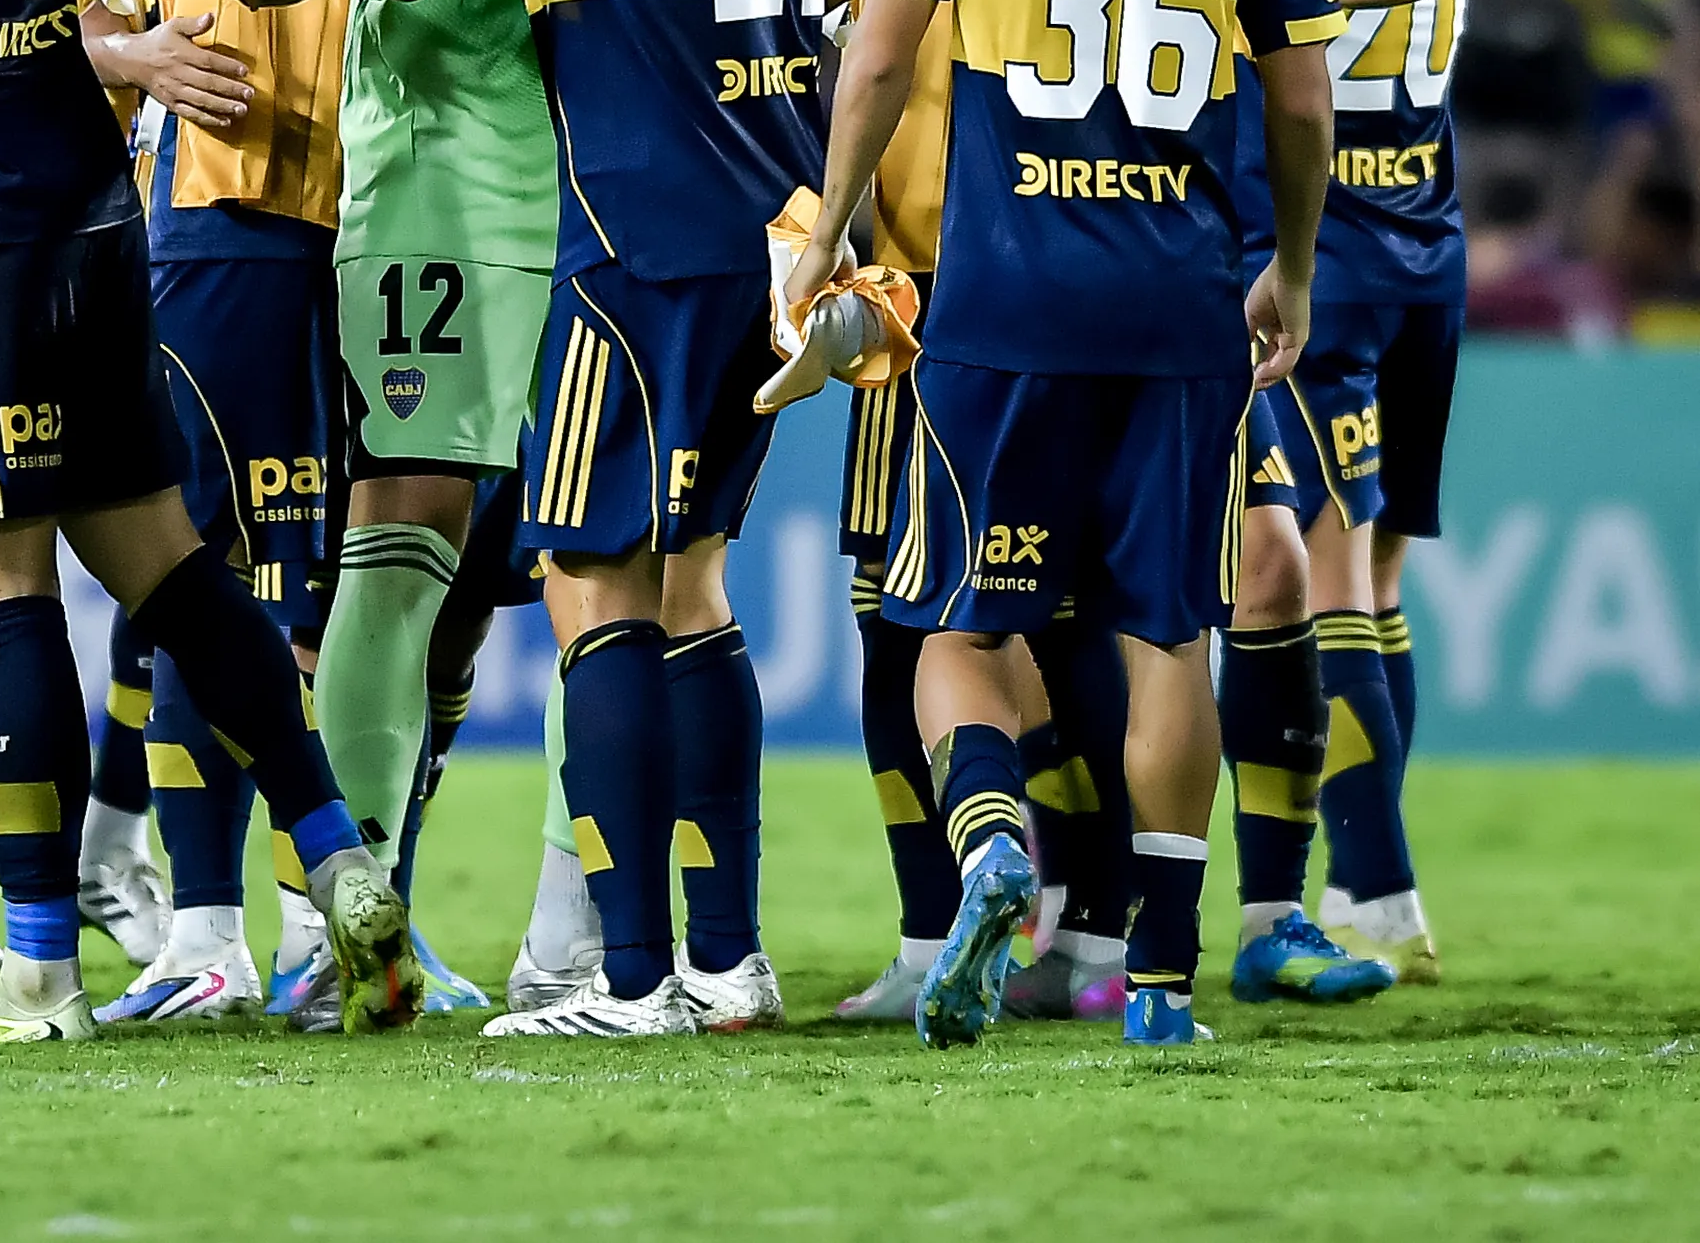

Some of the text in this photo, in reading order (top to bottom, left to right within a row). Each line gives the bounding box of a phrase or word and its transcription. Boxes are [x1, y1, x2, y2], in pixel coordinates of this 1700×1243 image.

[1014, 152, 1193, 203] DIRECTV
[377, 262, 465, 356] 12
[385, 384, 422, 396] CABJ
